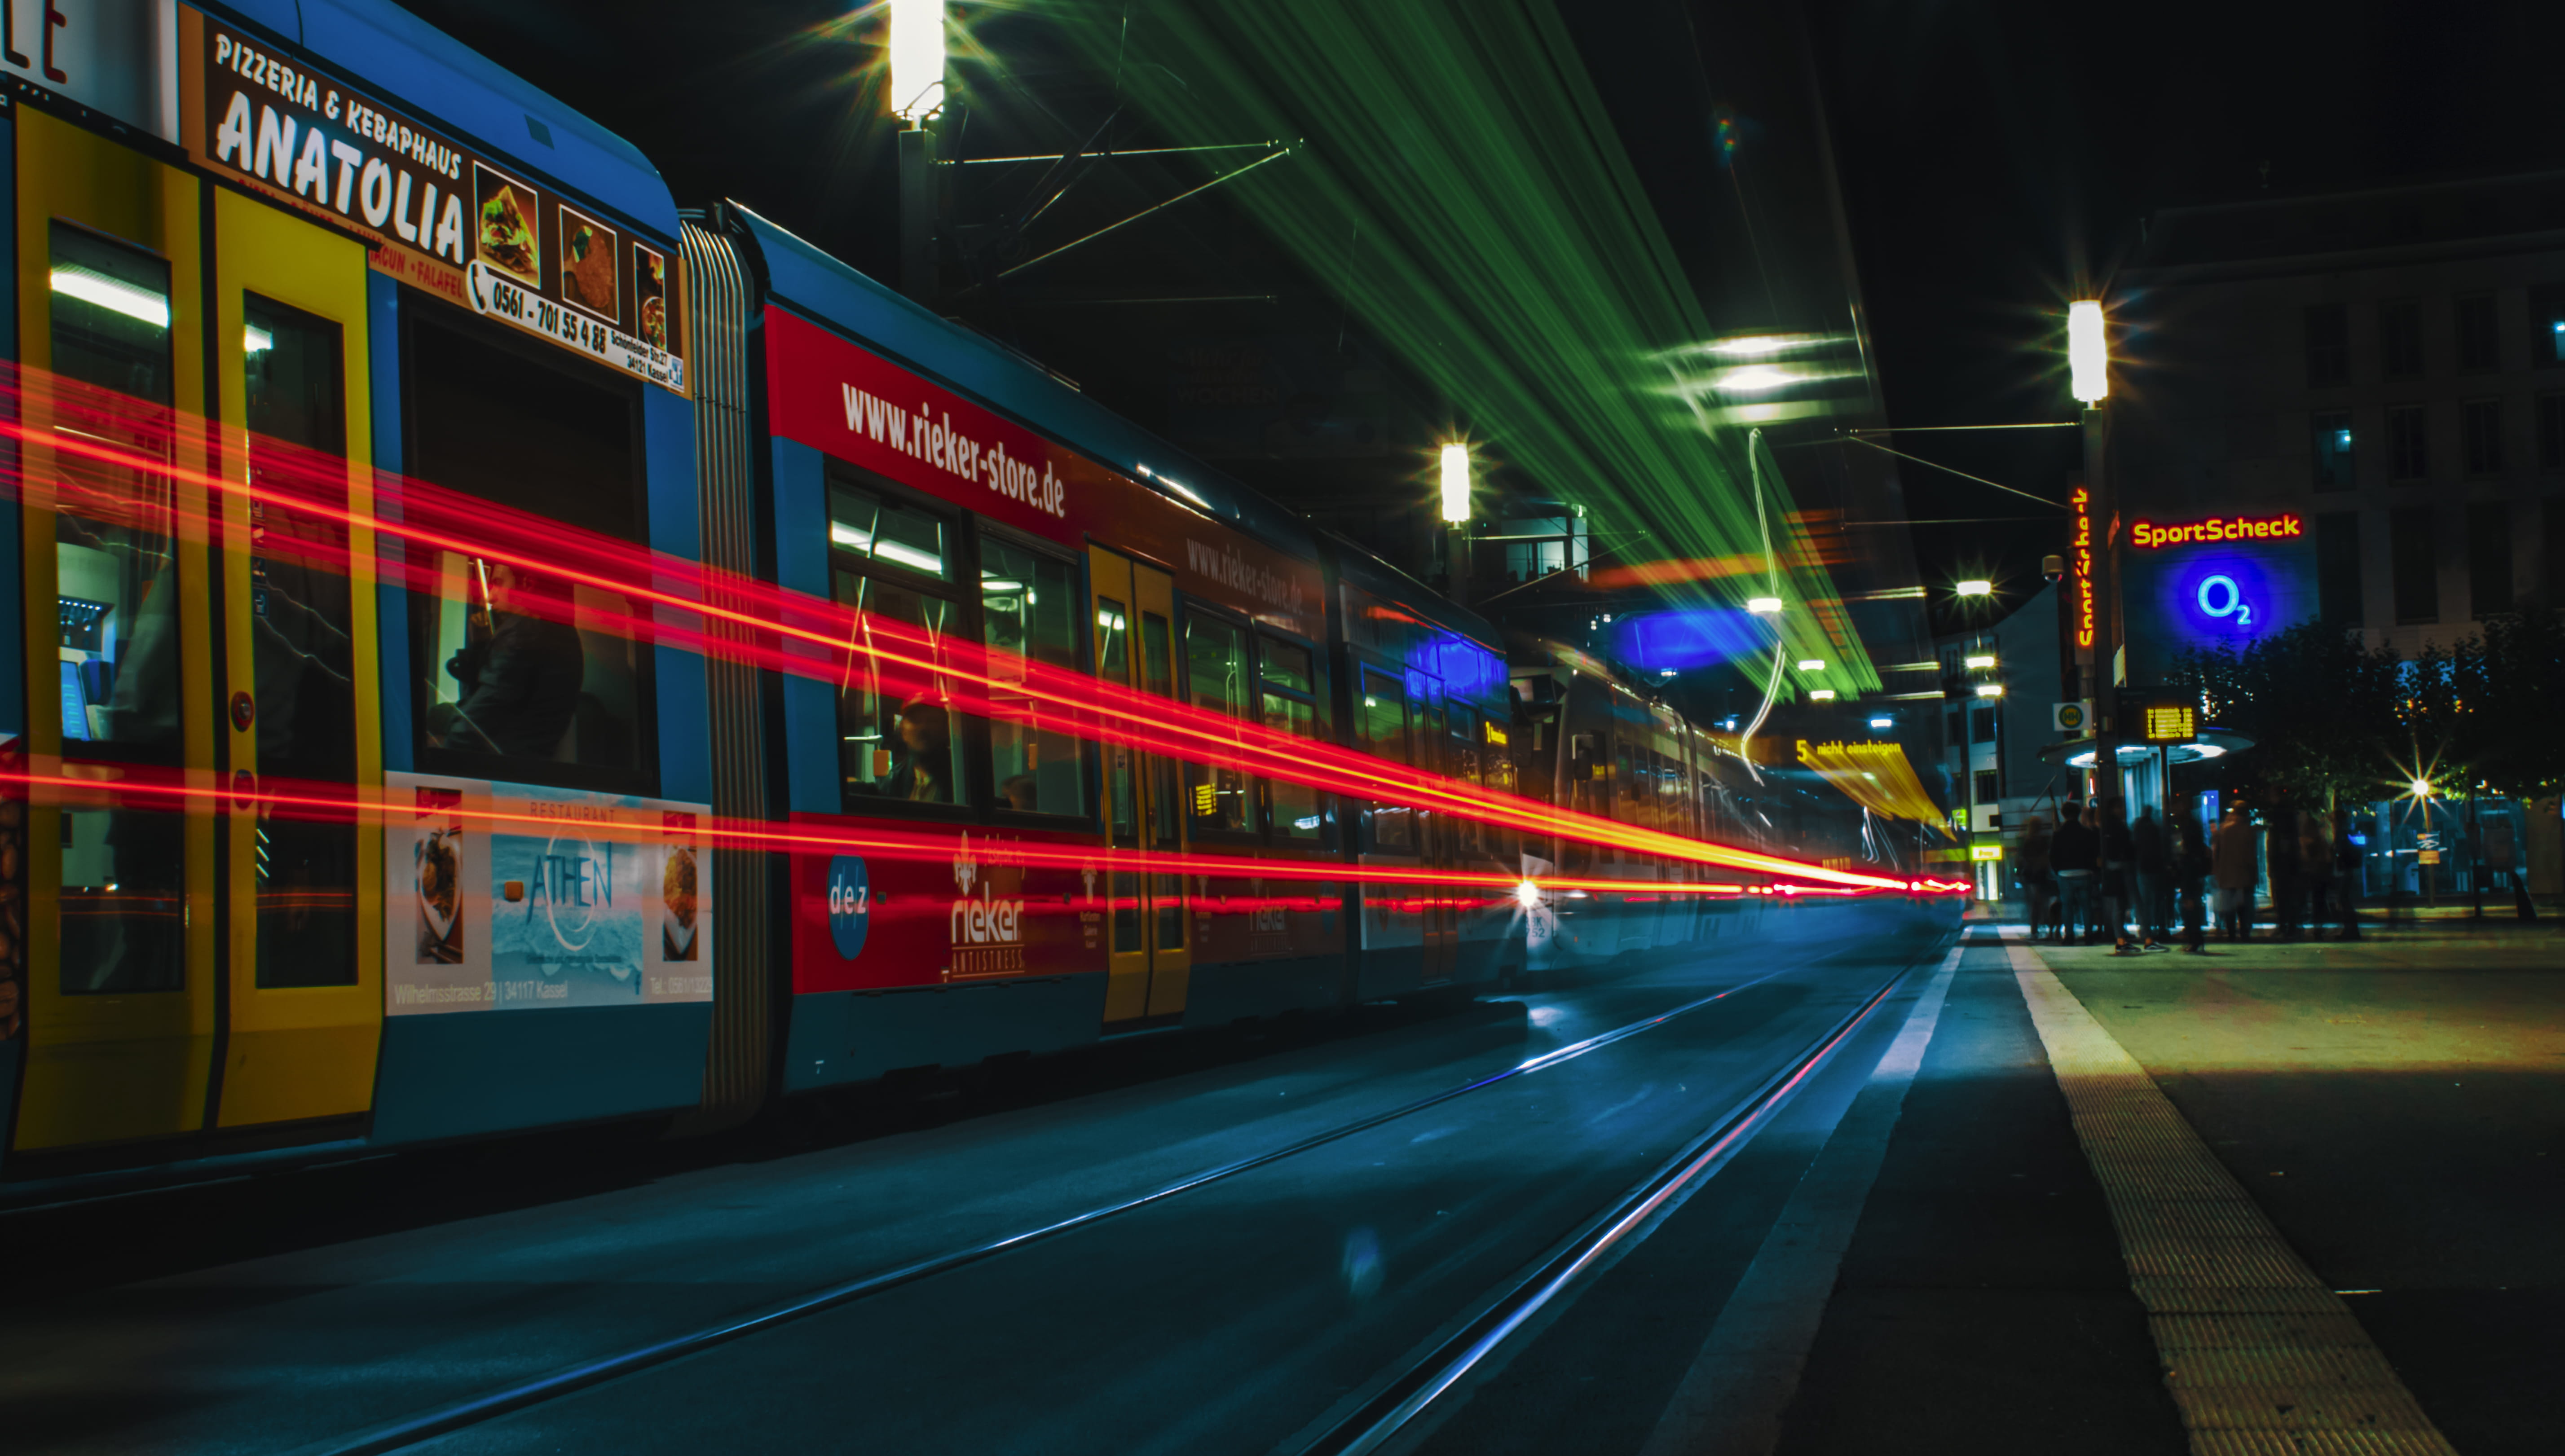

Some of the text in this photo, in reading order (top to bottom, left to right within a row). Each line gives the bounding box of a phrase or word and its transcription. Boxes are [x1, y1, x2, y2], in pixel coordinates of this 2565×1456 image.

[216, 33, 462, 180] PIZZERIA & KEBAPHAUS
[216, 91, 464, 264] ANATOLIA
[417, 260, 463, 298] FALAFEL
[494, 282, 524, 319] 0561
[538, 301, 559, 334] 701
[562, 312, 578, 342] 55
[581, 320, 589, 347] 4
[592, 325, 606, 354] 88
[842, 382, 1065, 518] www.rieker-store.de
[2133, 515, 2300, 546] SportScheck
[1186, 537, 1303, 616] www.rieker-store.de
[1797, 739, 1901, 762] 5 nicht einsteigen
[530, 802, 615, 823] RESTAURANT
[526, 841, 612, 925] ATHEN
[829, 874, 867, 914] dez
[951, 881, 1024, 943] rieker
[952, 948, 1022, 973] ANTISTRESS
[484, 981, 495, 1001] 29
[505, 981, 533, 1000] 34117
[537, 980, 568, 999] Kassel
